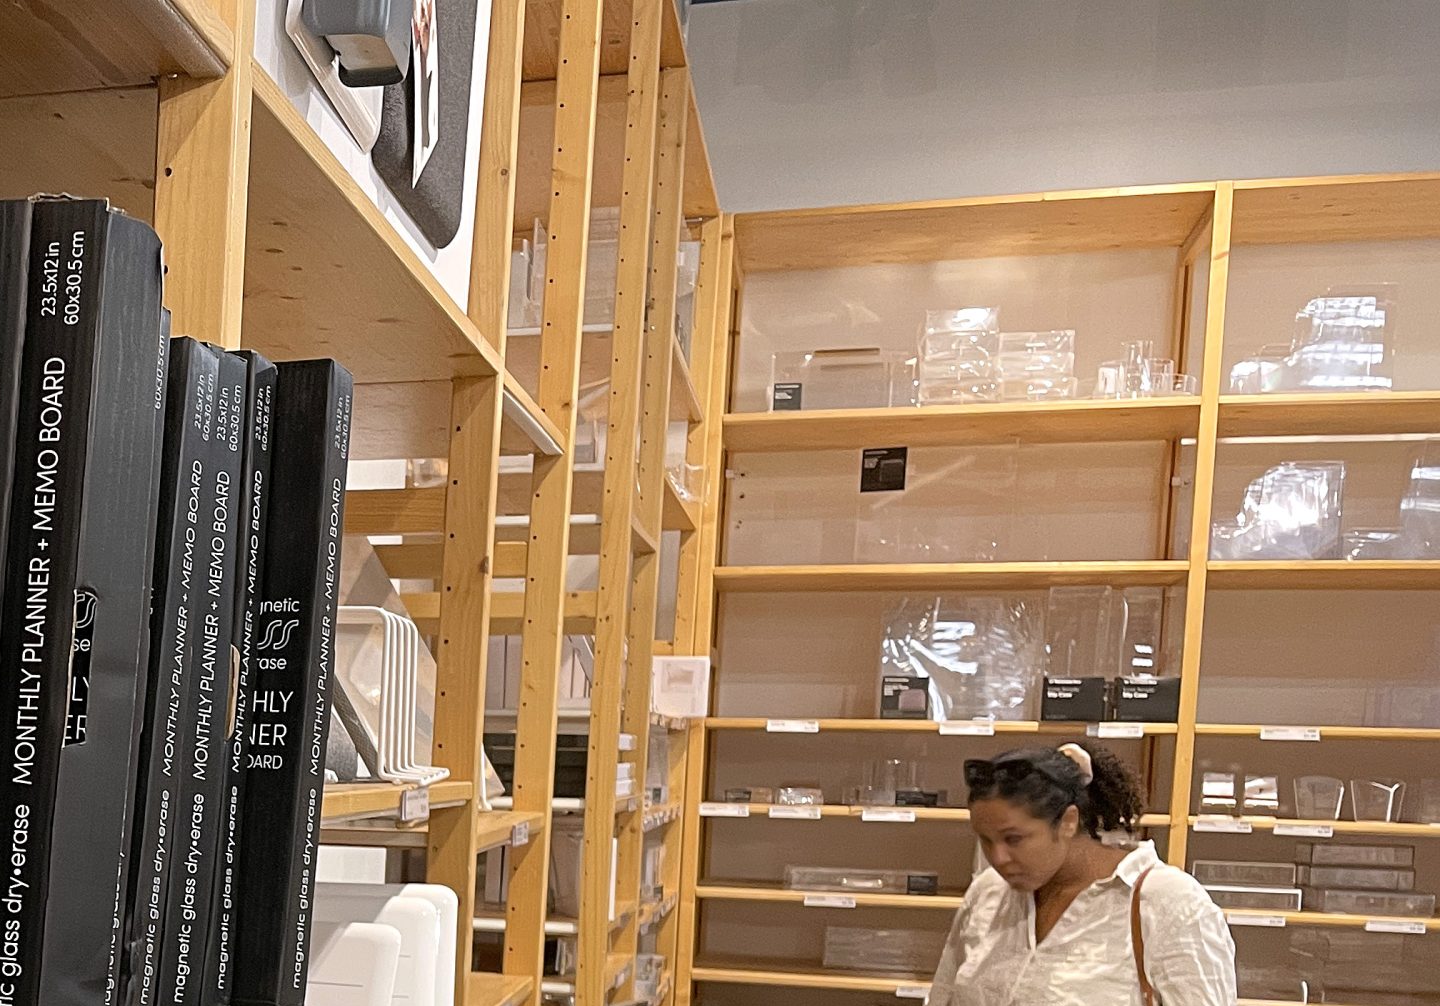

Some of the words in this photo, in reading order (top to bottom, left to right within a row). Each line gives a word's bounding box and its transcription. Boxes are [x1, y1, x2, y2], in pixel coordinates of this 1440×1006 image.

[41, 242, 59, 316] 23.5x12in
[64, 231, 85, 325] 60x30.5cm
[40, 357, 65, 442] BOARD
[33, 450, 58, 531] MEMO
[187, 460, 203, 524] BOARD
[214, 470, 231, 539] BOARD
[252, 470, 263, 531] BOARD
[330, 478, 341, 539] BOARD
[182, 526, 196, 589] MEMO
[207, 537, 225, 597] MEMO
[247, 534, 259, 593] MEMO
[325, 540, 336, 599] MEMO
[22, 557, 50, 662] PLANNER
[260, 598, 300, 615] netic
[172, 605, 188, 685] PLANNER
[200, 613, 219, 691] PLANNER
[240, 610, 253, 686] PLANNER
[318, 616, 331, 690] PLANNER
[12, 668, 41, 784] MONTHLY
[163, 688, 179, 776] MONTHLY
[193, 694, 213, 780] MONTHLY
[232, 689, 247, 772] MONTHLY
[310, 693, 325, 775] MONTHLY
[2, 804, 29, 913] dry•erase
[154, 789, 170, 872] dry•erase
[184, 793, 204, 874] dry•erase
[226, 786, 238, 864] dry•erase
[303, 788, 316, 865] dry•erase
[149, 876, 160, 920] glass
[181, 878, 197, 920] glass
[223, 868, 232, 909] glass
[300, 868, 309, 909] glass
[140, 924, 157, 1004] magnetic
[174, 924, 191, 1003] magnetic
[217, 914, 230, 990] magnetic
[293, 913, 306, 988] magnetic
